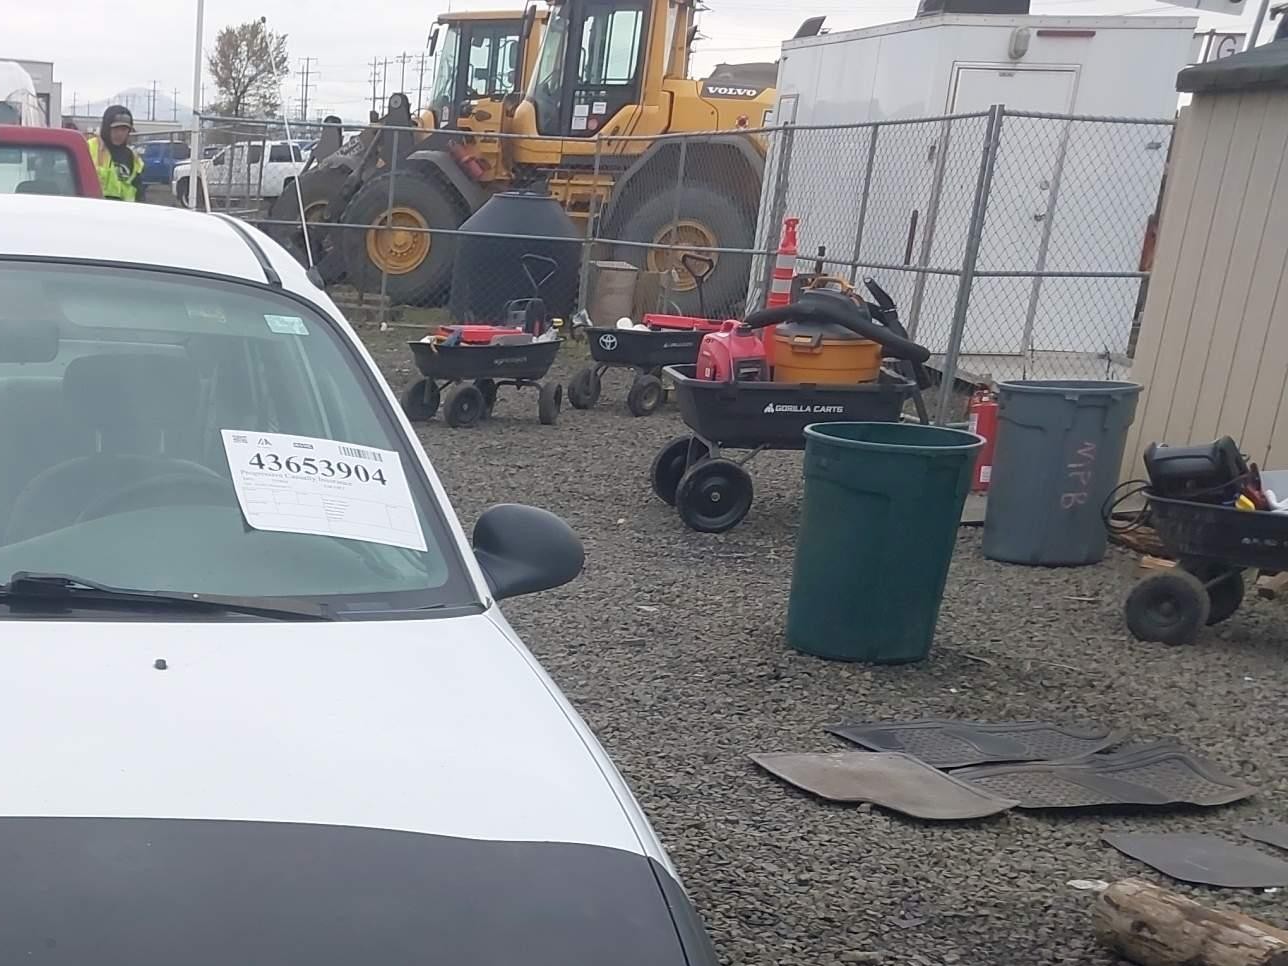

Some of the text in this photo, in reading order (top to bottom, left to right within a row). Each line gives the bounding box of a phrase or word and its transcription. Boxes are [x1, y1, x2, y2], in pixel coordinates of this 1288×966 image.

[706, 86, 757, 97] VOLVO
[775, 404, 844, 413] GORILLA CARTS
[249, 452, 387, 486] 43653904
